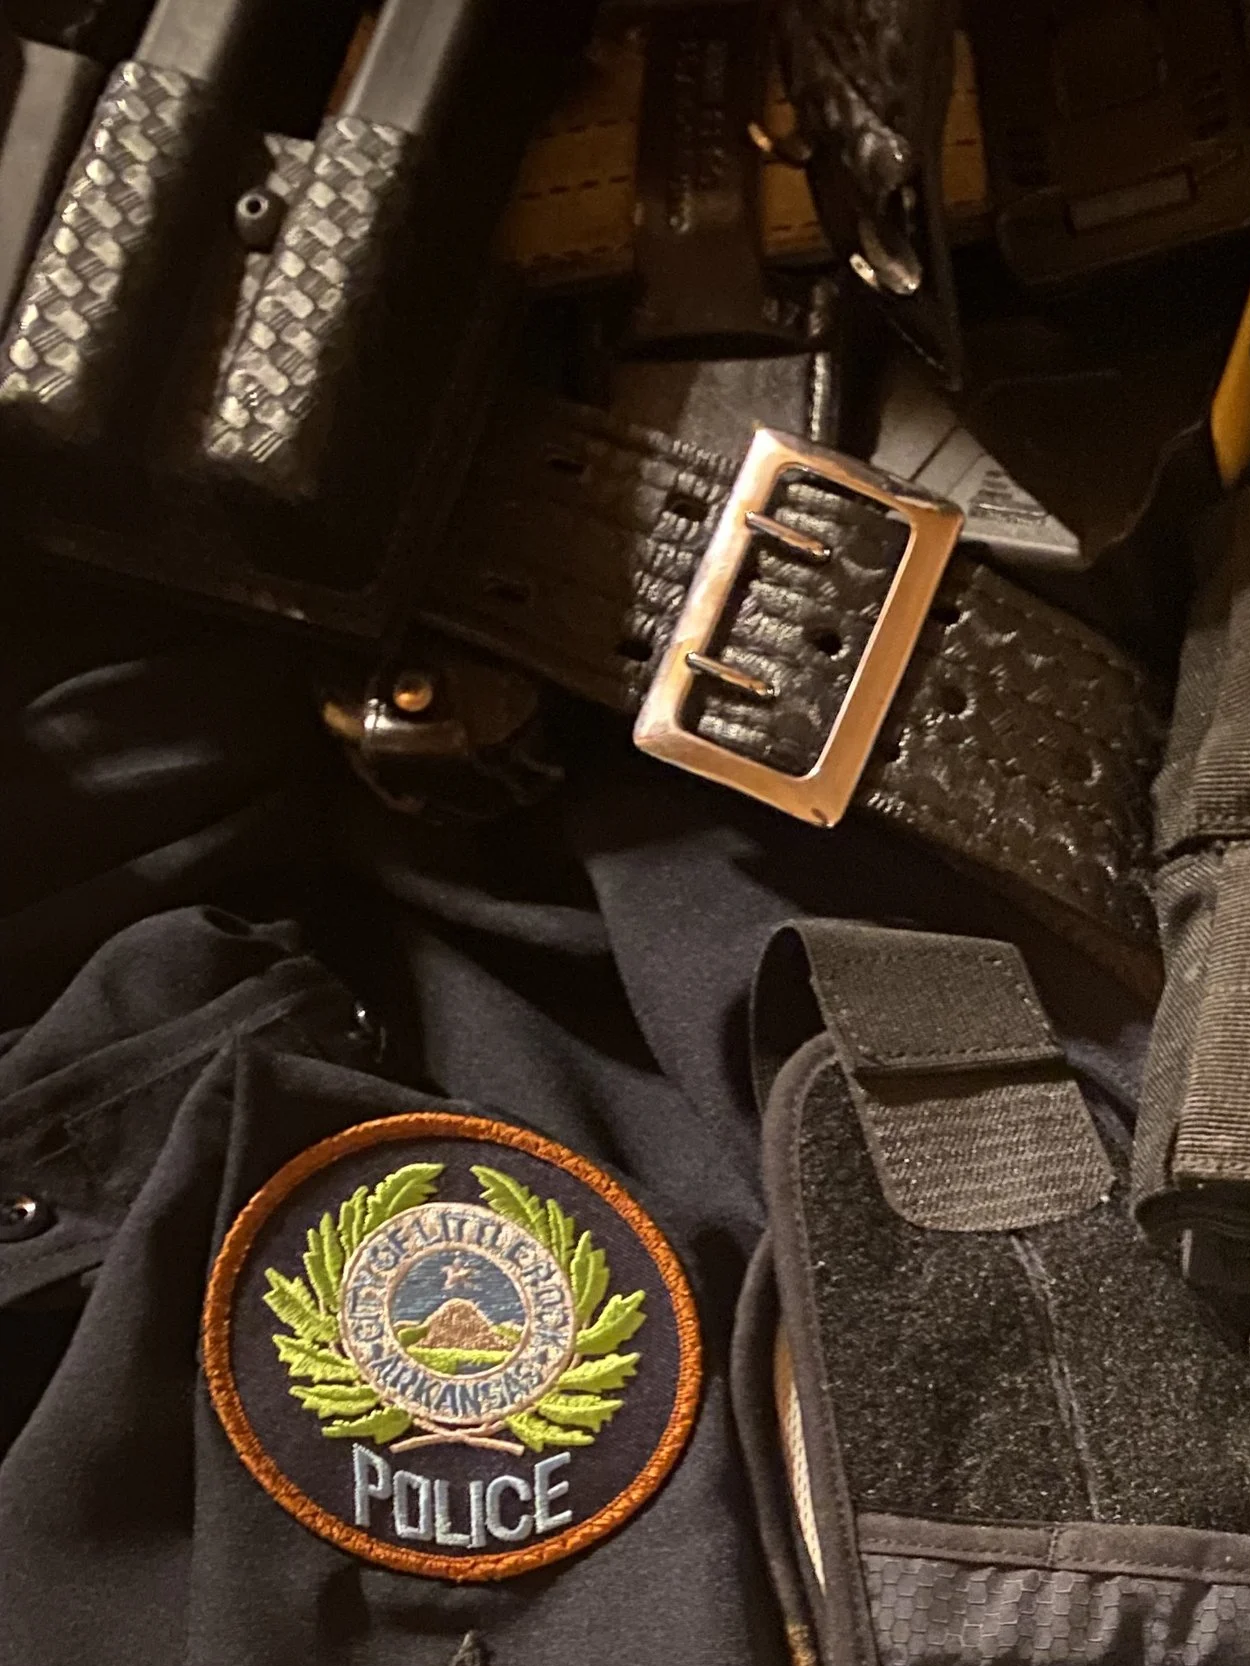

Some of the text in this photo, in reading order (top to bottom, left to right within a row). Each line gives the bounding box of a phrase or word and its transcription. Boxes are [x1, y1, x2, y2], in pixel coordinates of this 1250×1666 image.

[347, 1211, 570, 1347] CITY OF LITTLE ROCK
[368, 1354, 543, 1417] ARKANSAS
[353, 1442, 573, 1549] POLICE
